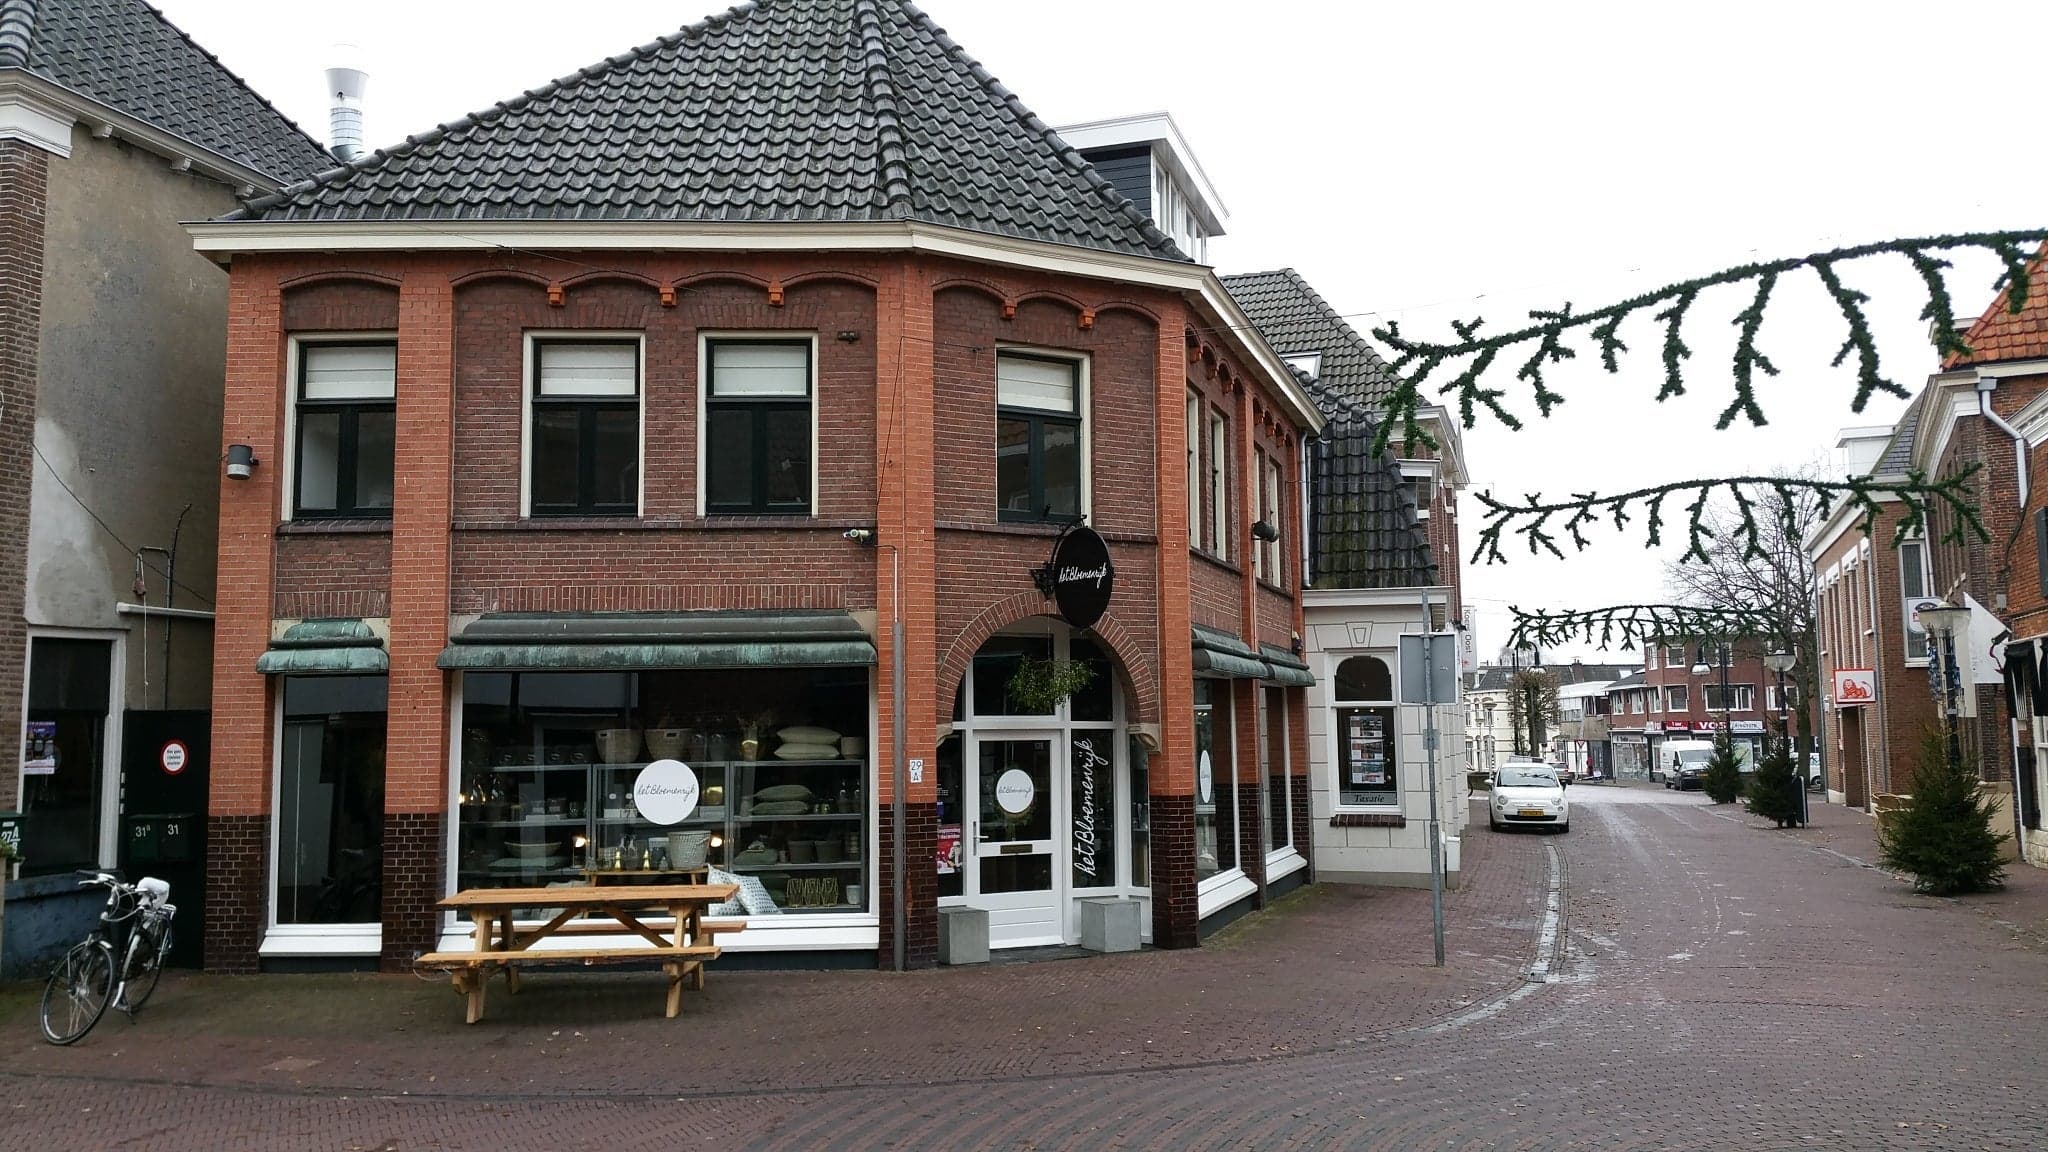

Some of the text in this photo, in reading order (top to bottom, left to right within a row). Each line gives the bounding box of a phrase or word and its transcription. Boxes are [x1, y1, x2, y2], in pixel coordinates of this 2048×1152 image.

[1699, 721, 1727, 730] VOS
[911, 760, 922, 771] 29
[167, 824, 179, 835] 31
